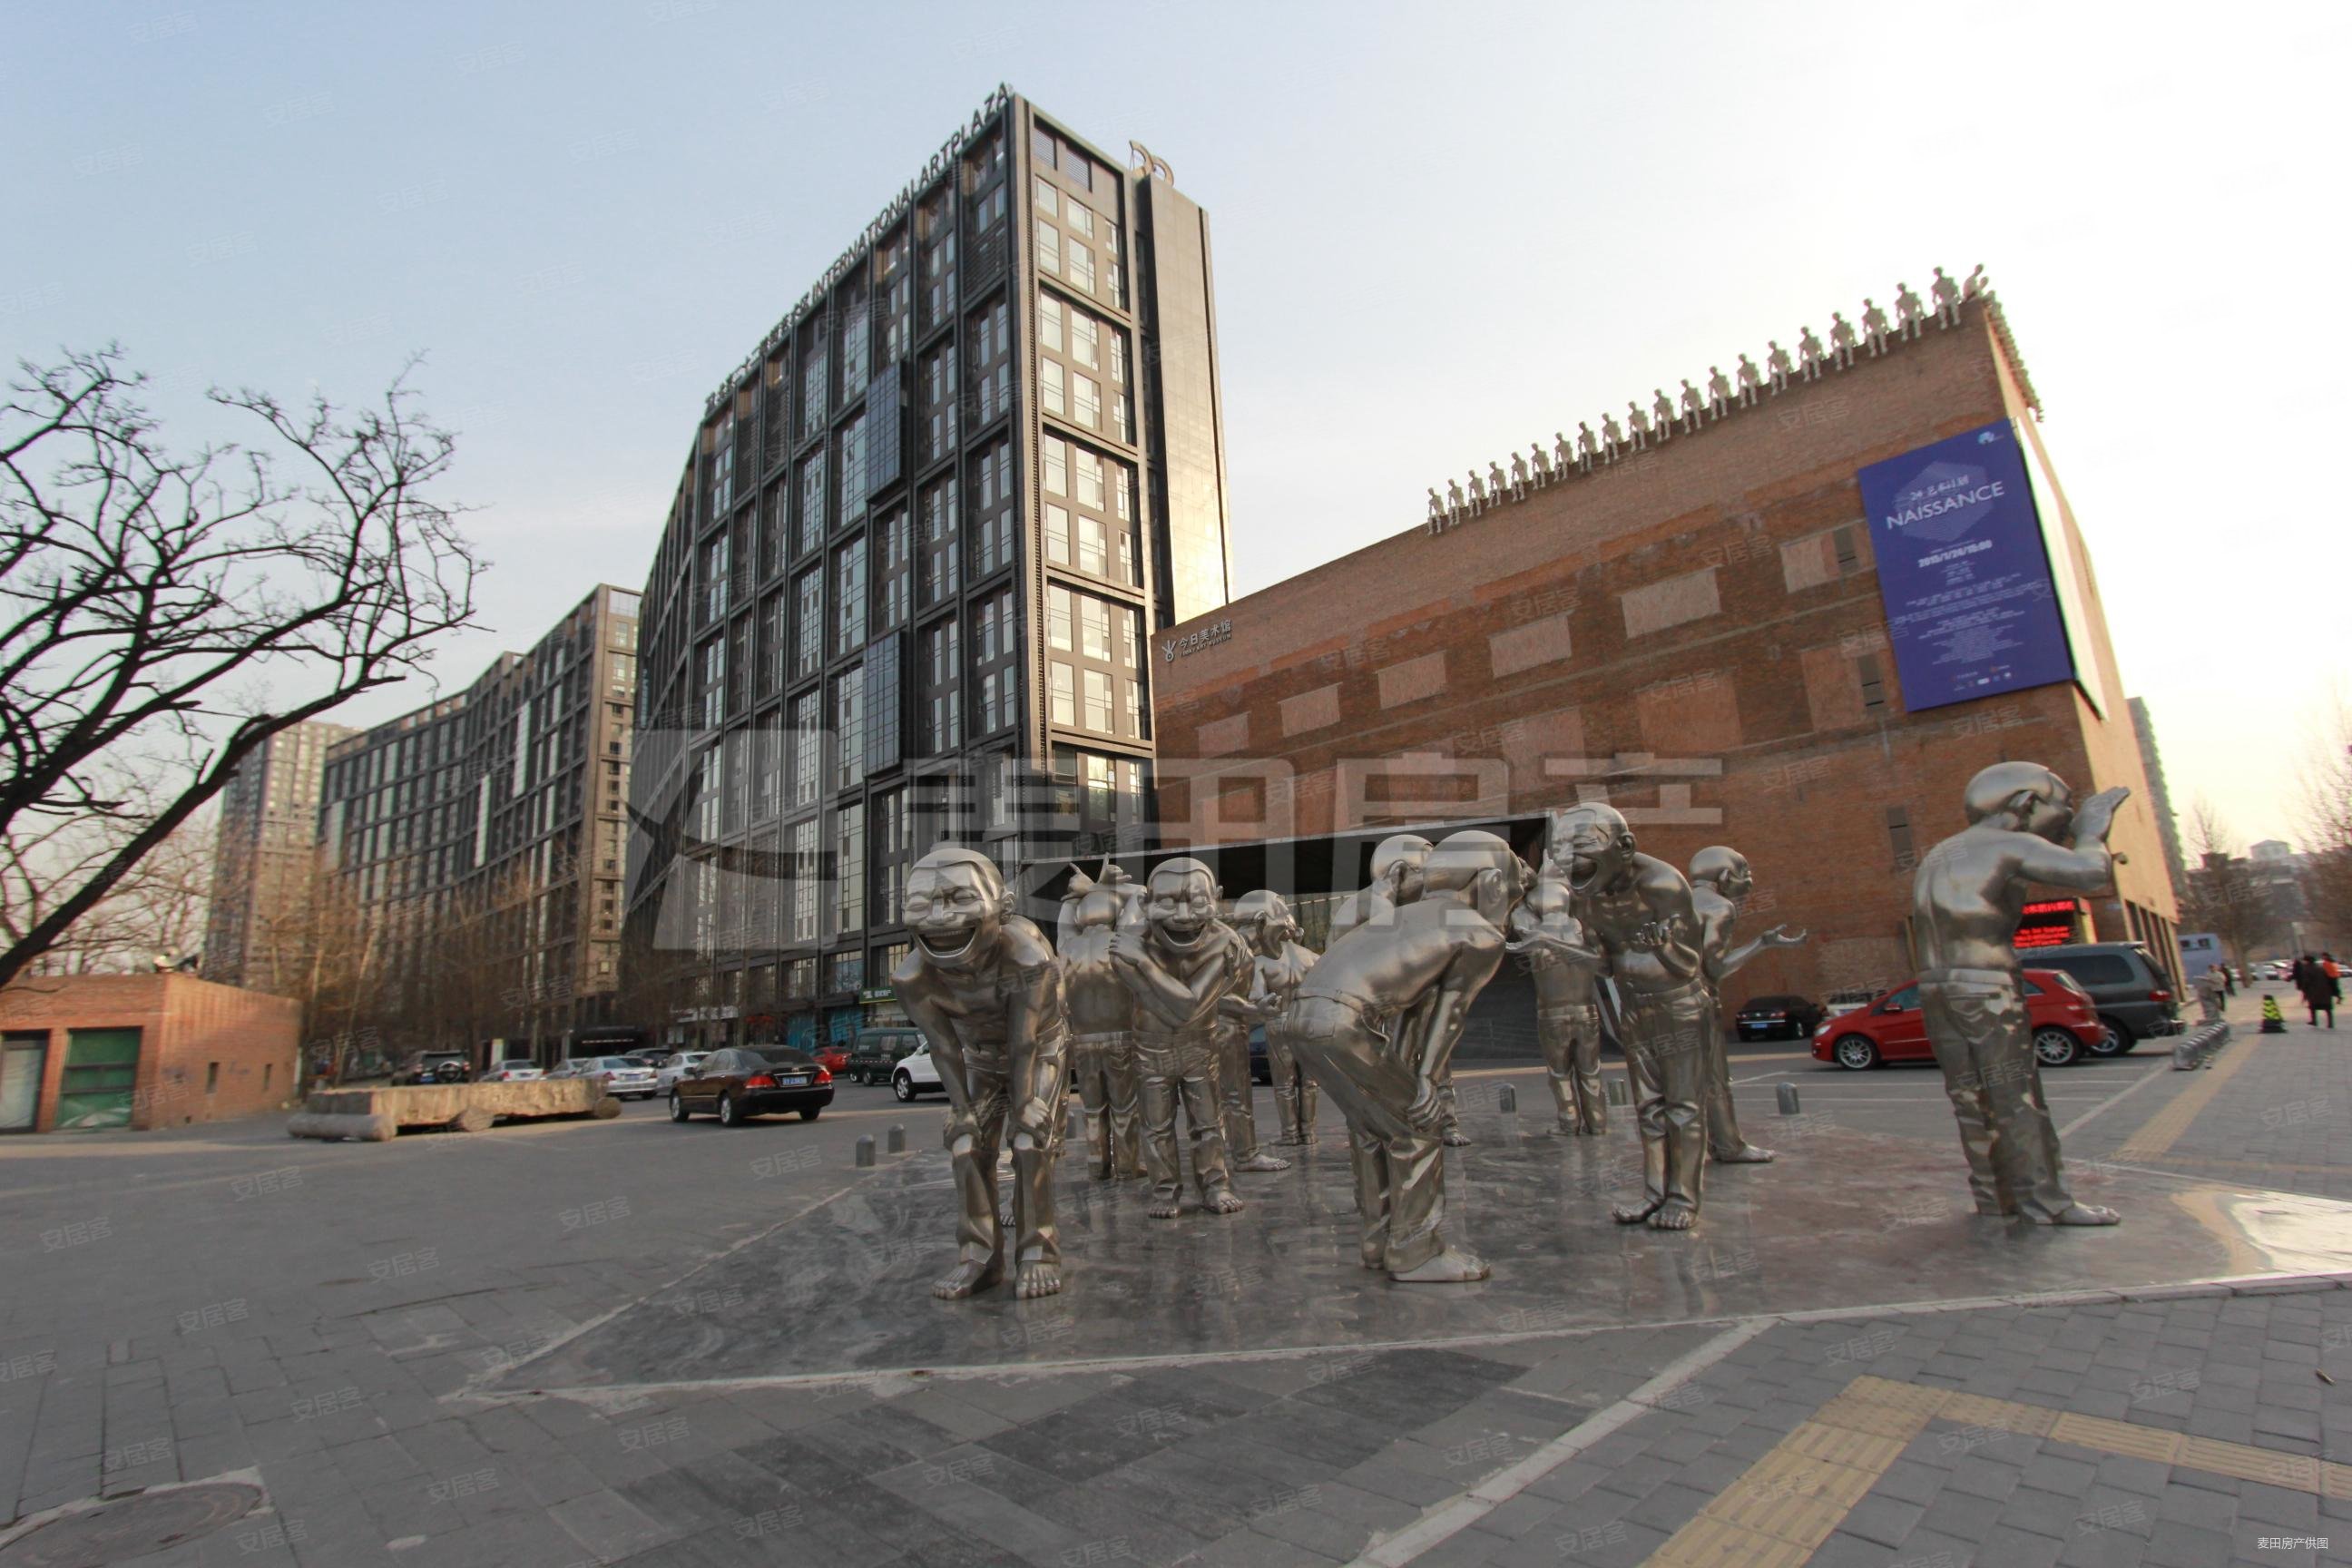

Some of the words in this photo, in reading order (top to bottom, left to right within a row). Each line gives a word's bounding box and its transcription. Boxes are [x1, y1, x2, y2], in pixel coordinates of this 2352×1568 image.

[1886, 481, 2004, 530] NAISSANCE
[1179, 619, 1232, 650] 今日美术馆
